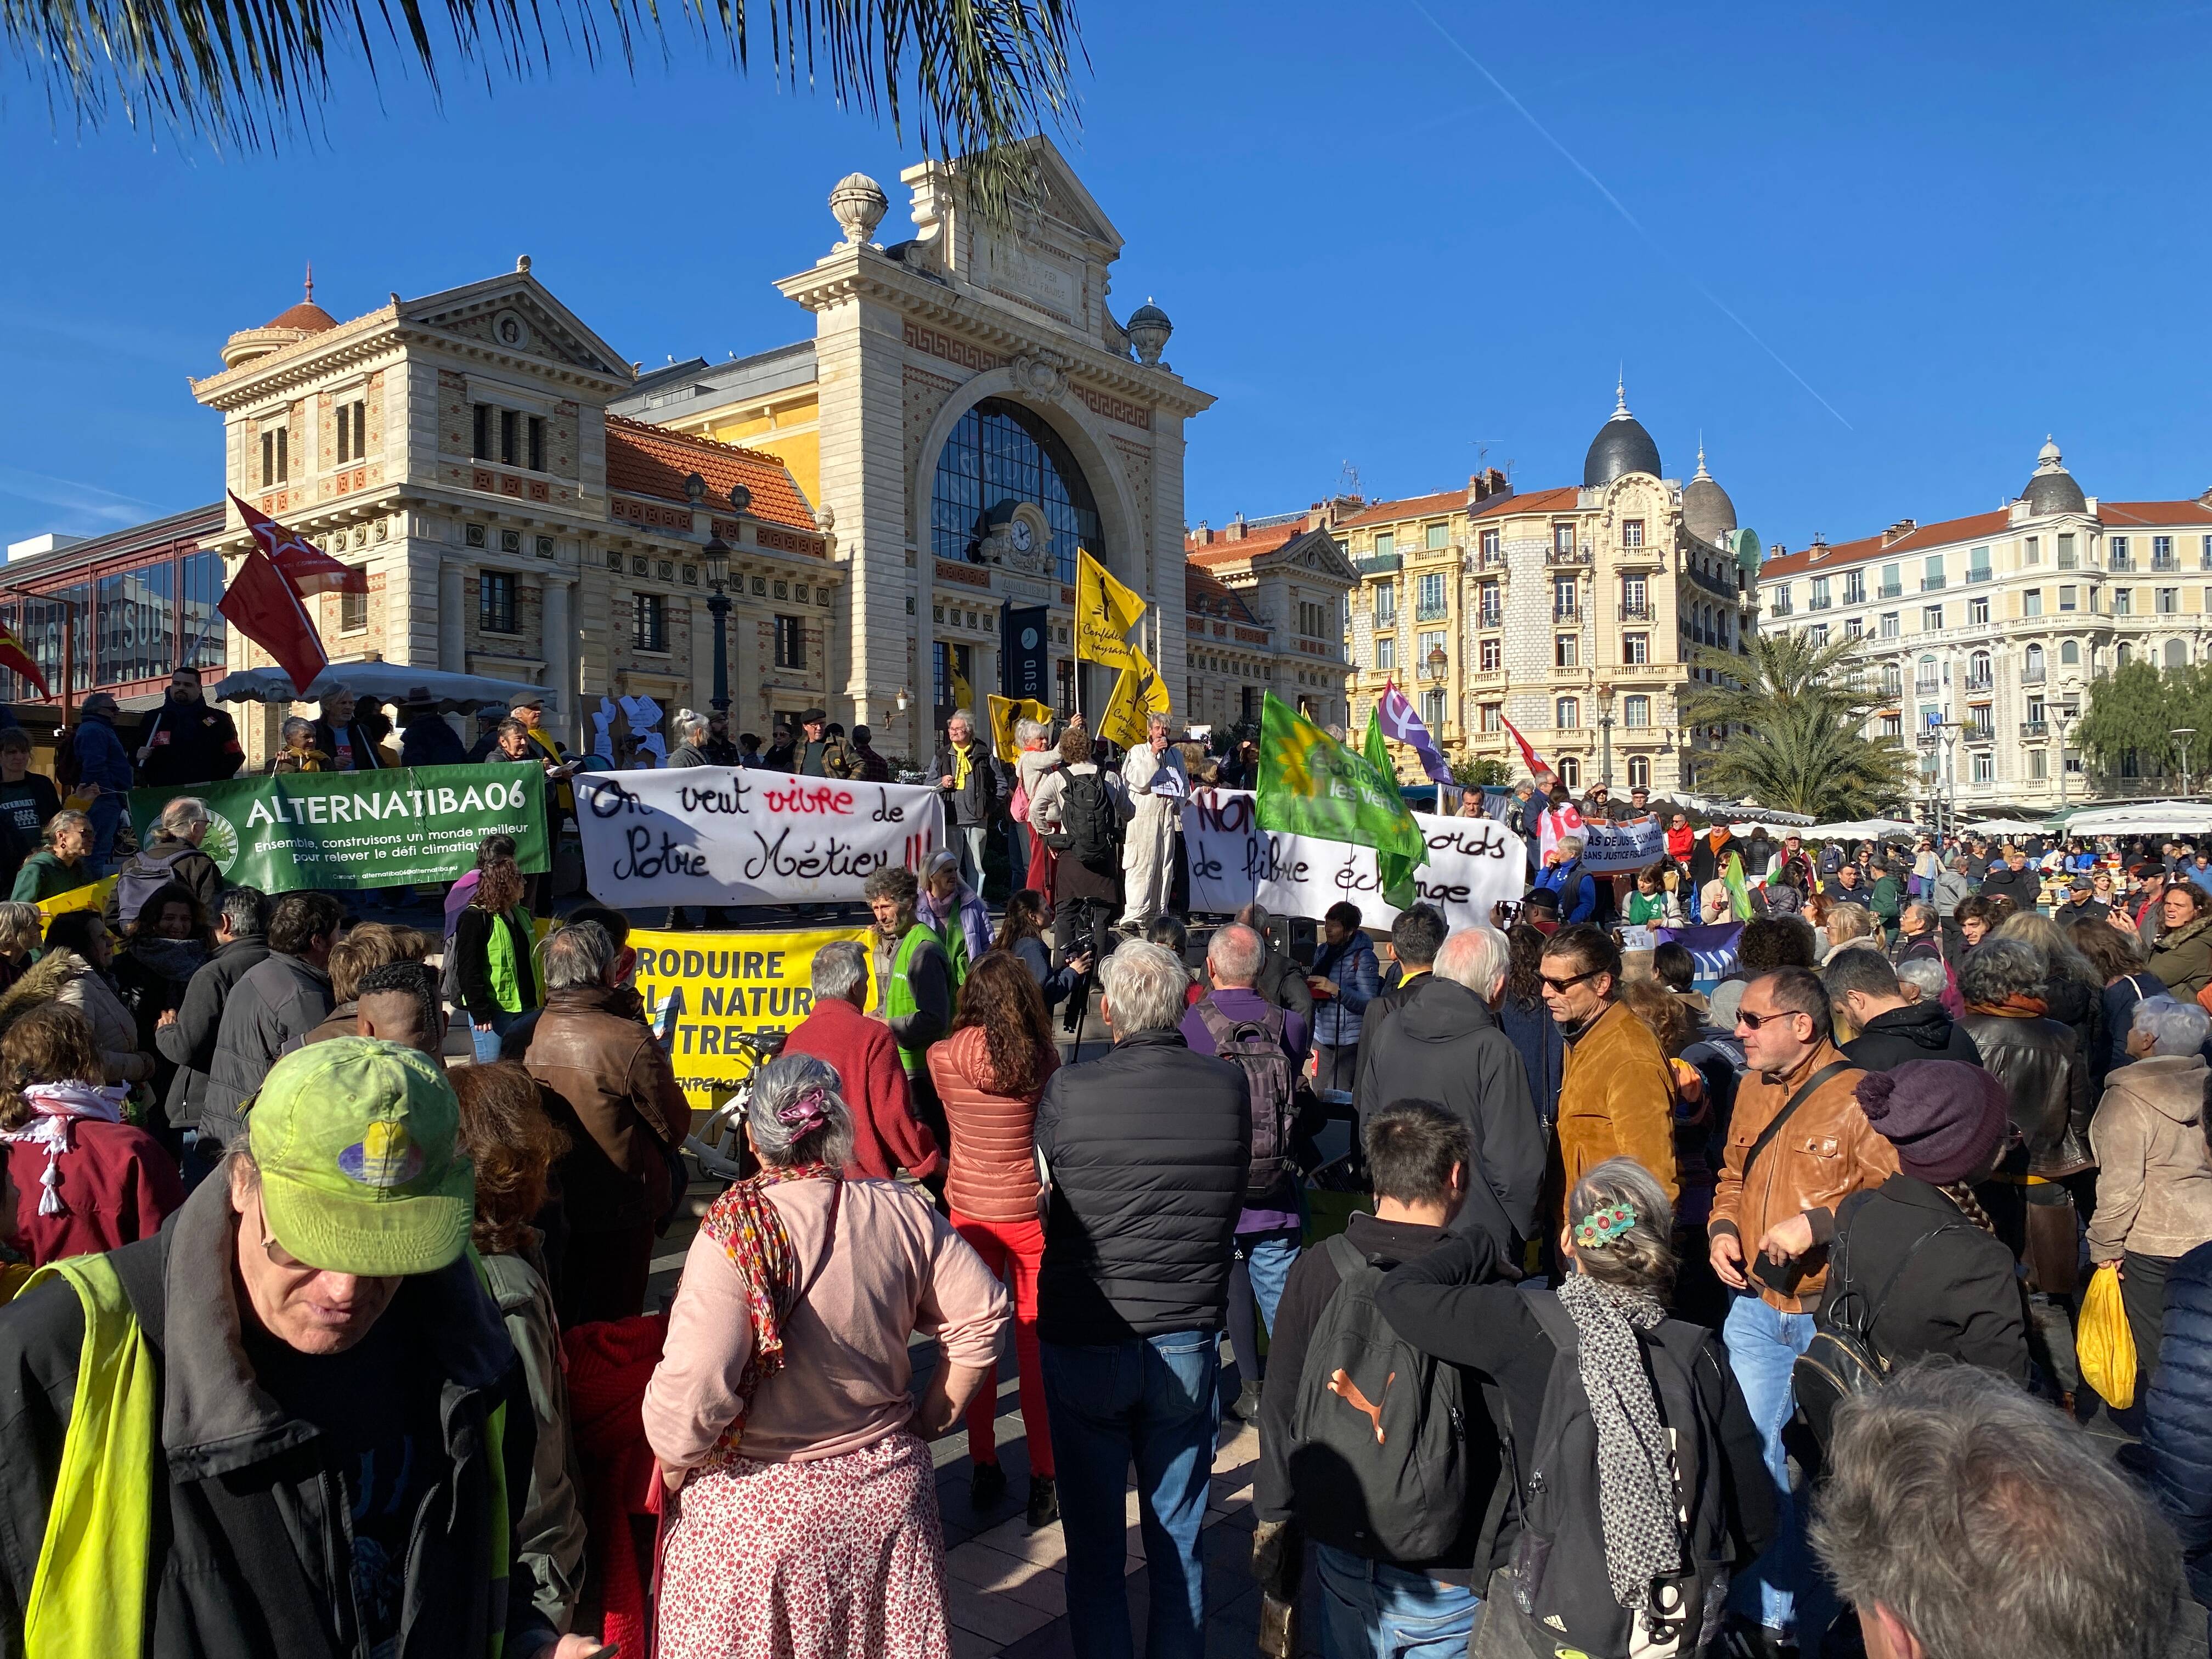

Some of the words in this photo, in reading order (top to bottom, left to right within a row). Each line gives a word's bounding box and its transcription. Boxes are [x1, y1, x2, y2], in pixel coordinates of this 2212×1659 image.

[1030, 583, 1046, 596] 1892
[124, 599, 163, 648] SUD
[1024, 659, 1037, 691] SUD
[246, 779, 526, 828] ALTERNATIBA06
[591, 777, 653, 819] On
[676, 777, 752, 815] veut
[872, 786, 905, 822] de
[1329, 777, 1357, 800] les
[255, 837, 318, 853] Ensemble,
[322, 834, 402, 848] construisons
[407, 833, 424, 843] un
[428, 827, 473, 840] monde
[478, 823, 528, 836] meilleur
[292, 853, 320, 864] pour
[324, 851, 370, 862] relever
[375, 849, 387, 860] le
[392, 847, 417, 857] défi
[422, 840, 481, 855] climatiqu
[1422, 826, 1506, 859] ords
[1587, 836, 1602, 847] AS
[1604, 836, 1617, 847] DE
[1618, 837, 1637, 846] JUSTE
[1193, 840, 1222, 881] de
[1240, 836, 1310, 883] libre
[1583, 851, 1602, 860] SANS
[1603, 850, 1628, 860] JUSTICE
[362, 865, 458, 879] alternatiba06@alternatiba.eu
[636, 947, 786, 979] RODUIRE
[701, 986, 814, 1017] NATUR
[671, 1024, 743, 1055] TRE
